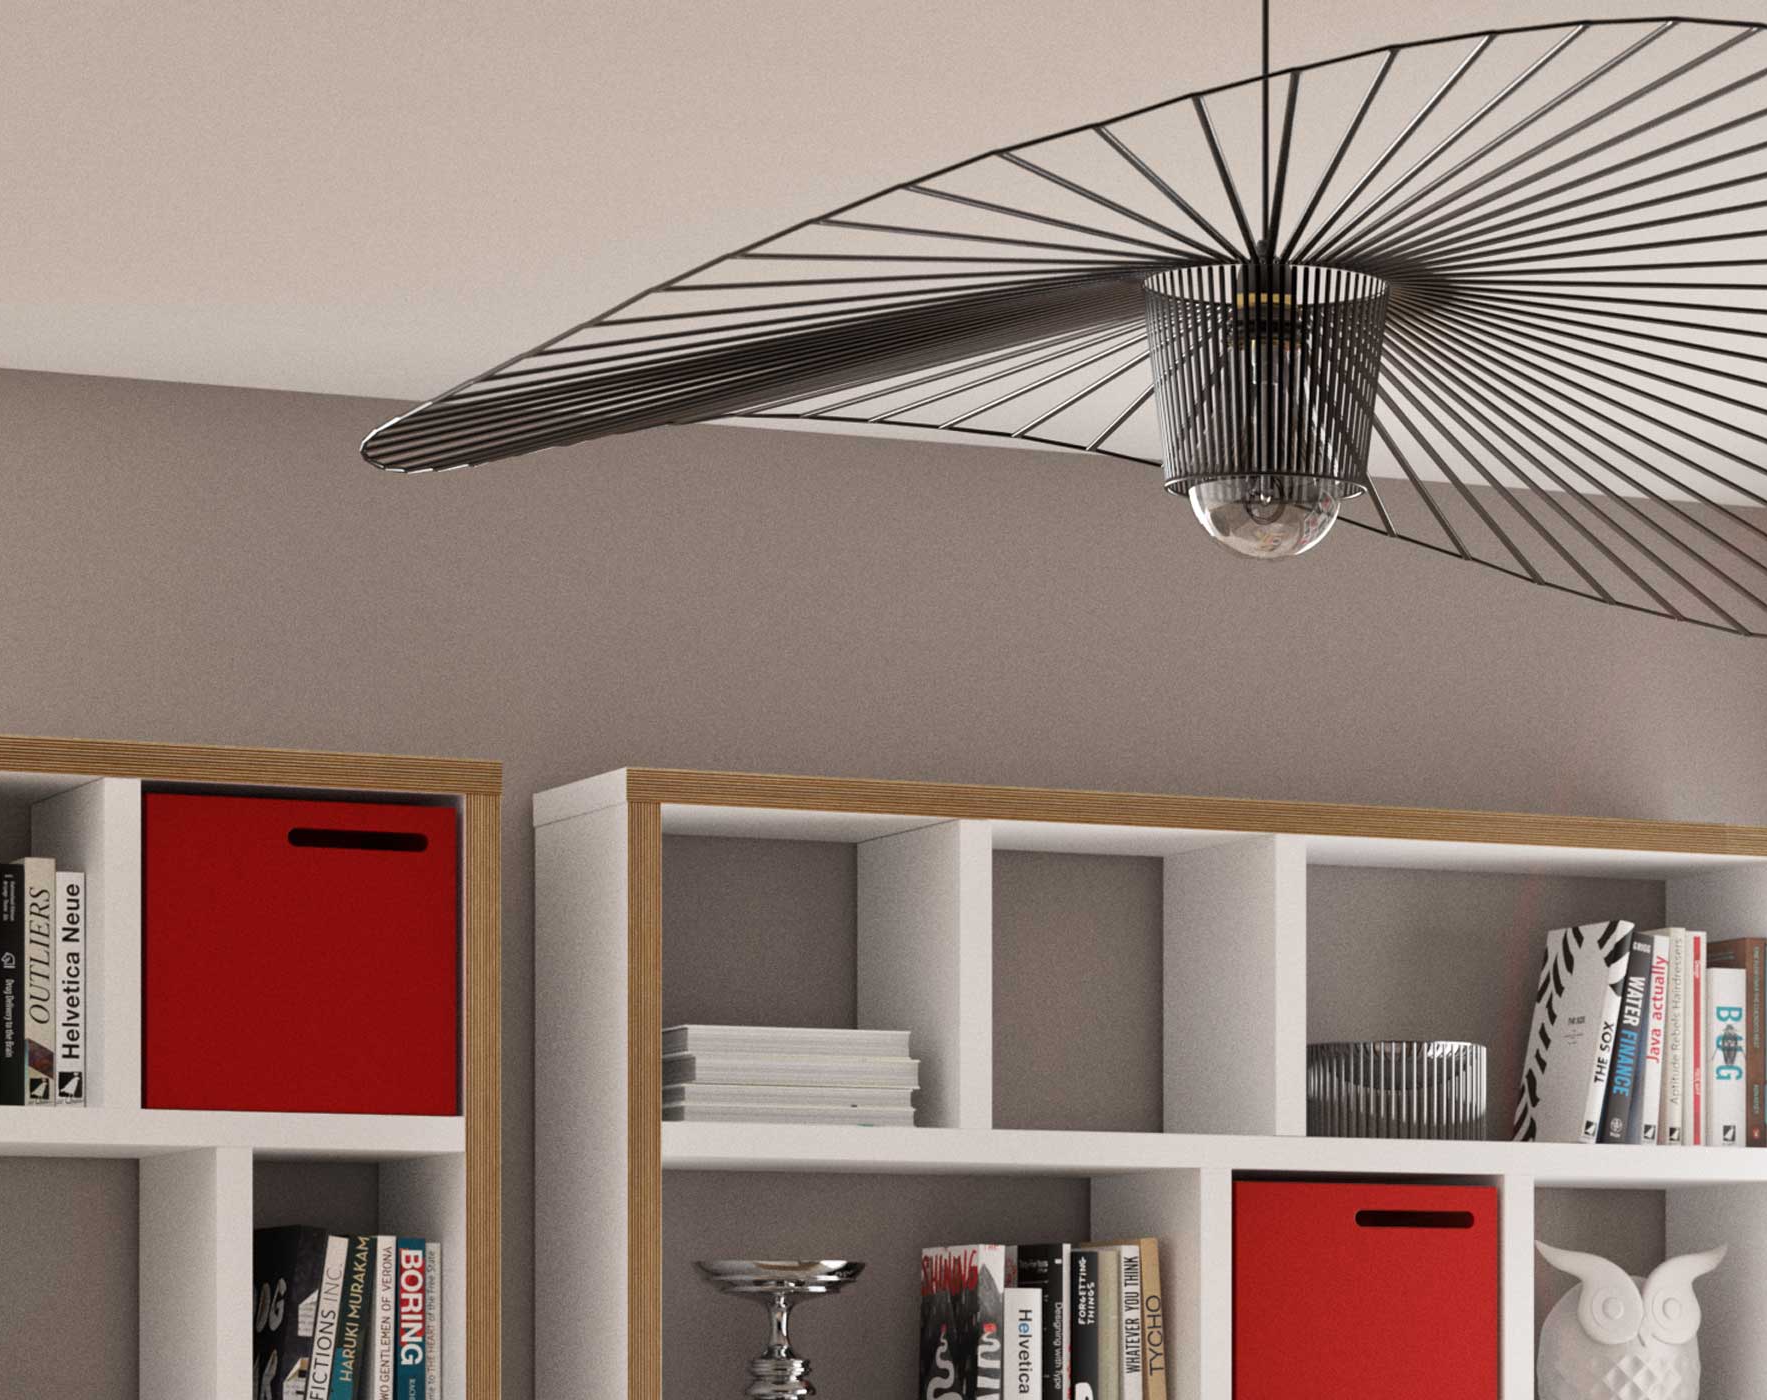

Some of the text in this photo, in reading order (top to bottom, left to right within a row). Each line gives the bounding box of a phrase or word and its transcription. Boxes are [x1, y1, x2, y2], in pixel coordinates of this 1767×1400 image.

[29, 887, 50, 1025] OUTLIERS
[62, 884, 80, 1060] Helvetica Neue
[1594, 1021, 1614, 1083] THE SOX
[1613, 976, 1645, 1097] WATER FINANCE
[1646, 956, 1670, 1063] Java actually
[324, 1263, 343, 1302] INC.
[381, 1299, 392, 1315] OF
[382, 1246, 393, 1298] VERONA
[400, 1249, 423, 1366] BORING
[1123, 1256, 1141, 1373] WHATEVER YOU THINK
[380, 1320, 392, 1390] GENTLEMEN
[1018, 1309, 1033, 1394] Helvetica
[1145, 1295, 1165, 1376] TYCHO
